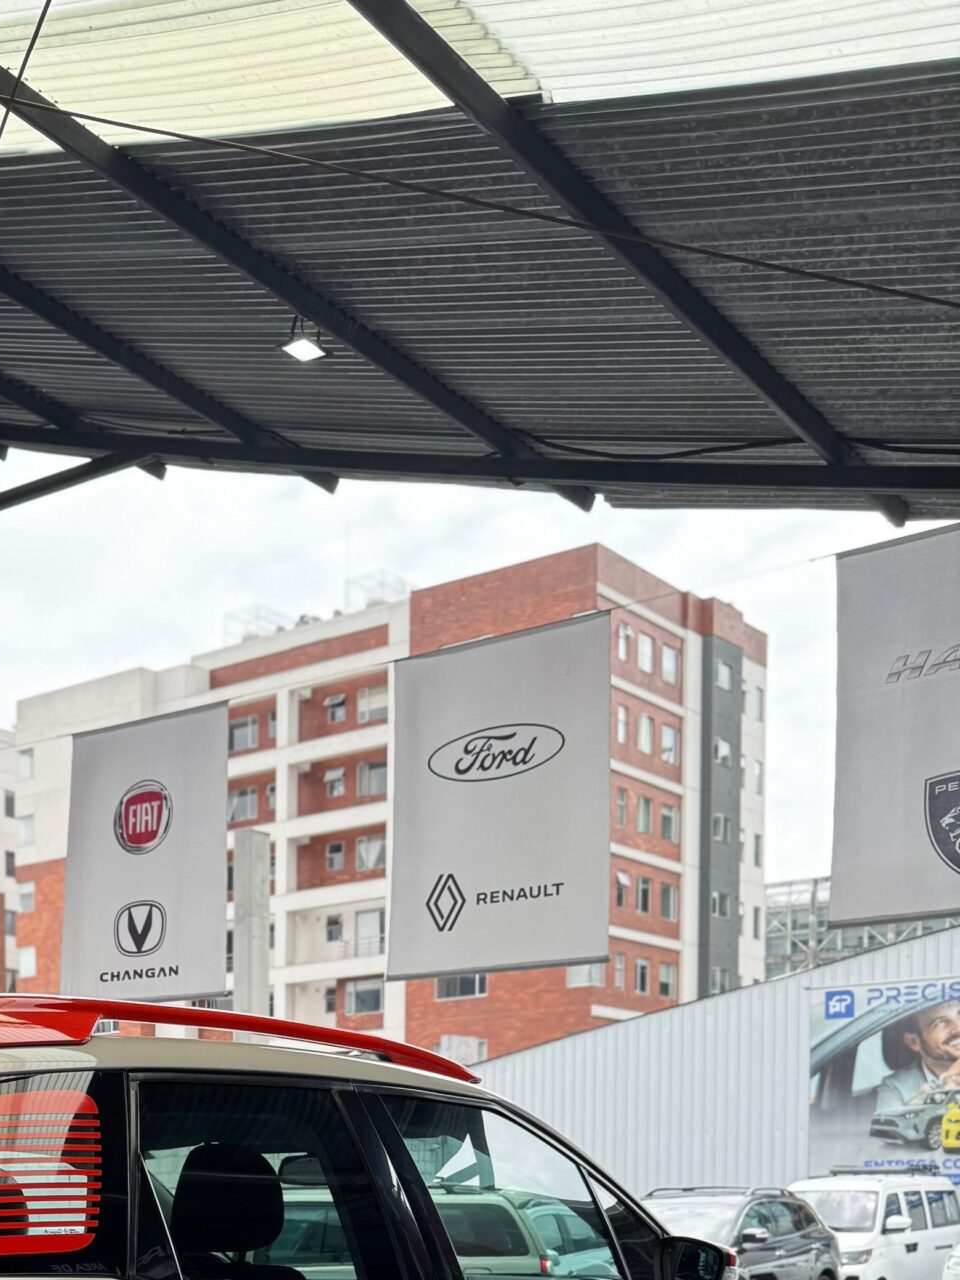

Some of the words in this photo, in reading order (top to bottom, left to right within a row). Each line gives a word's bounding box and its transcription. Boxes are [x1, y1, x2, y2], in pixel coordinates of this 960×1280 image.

[454, 731, 538, 775] Ford
[128, 800, 161, 835] FIAT
[476, 882, 565, 906] RENAULT
[99, 964, 180, 983] CHANGAN
